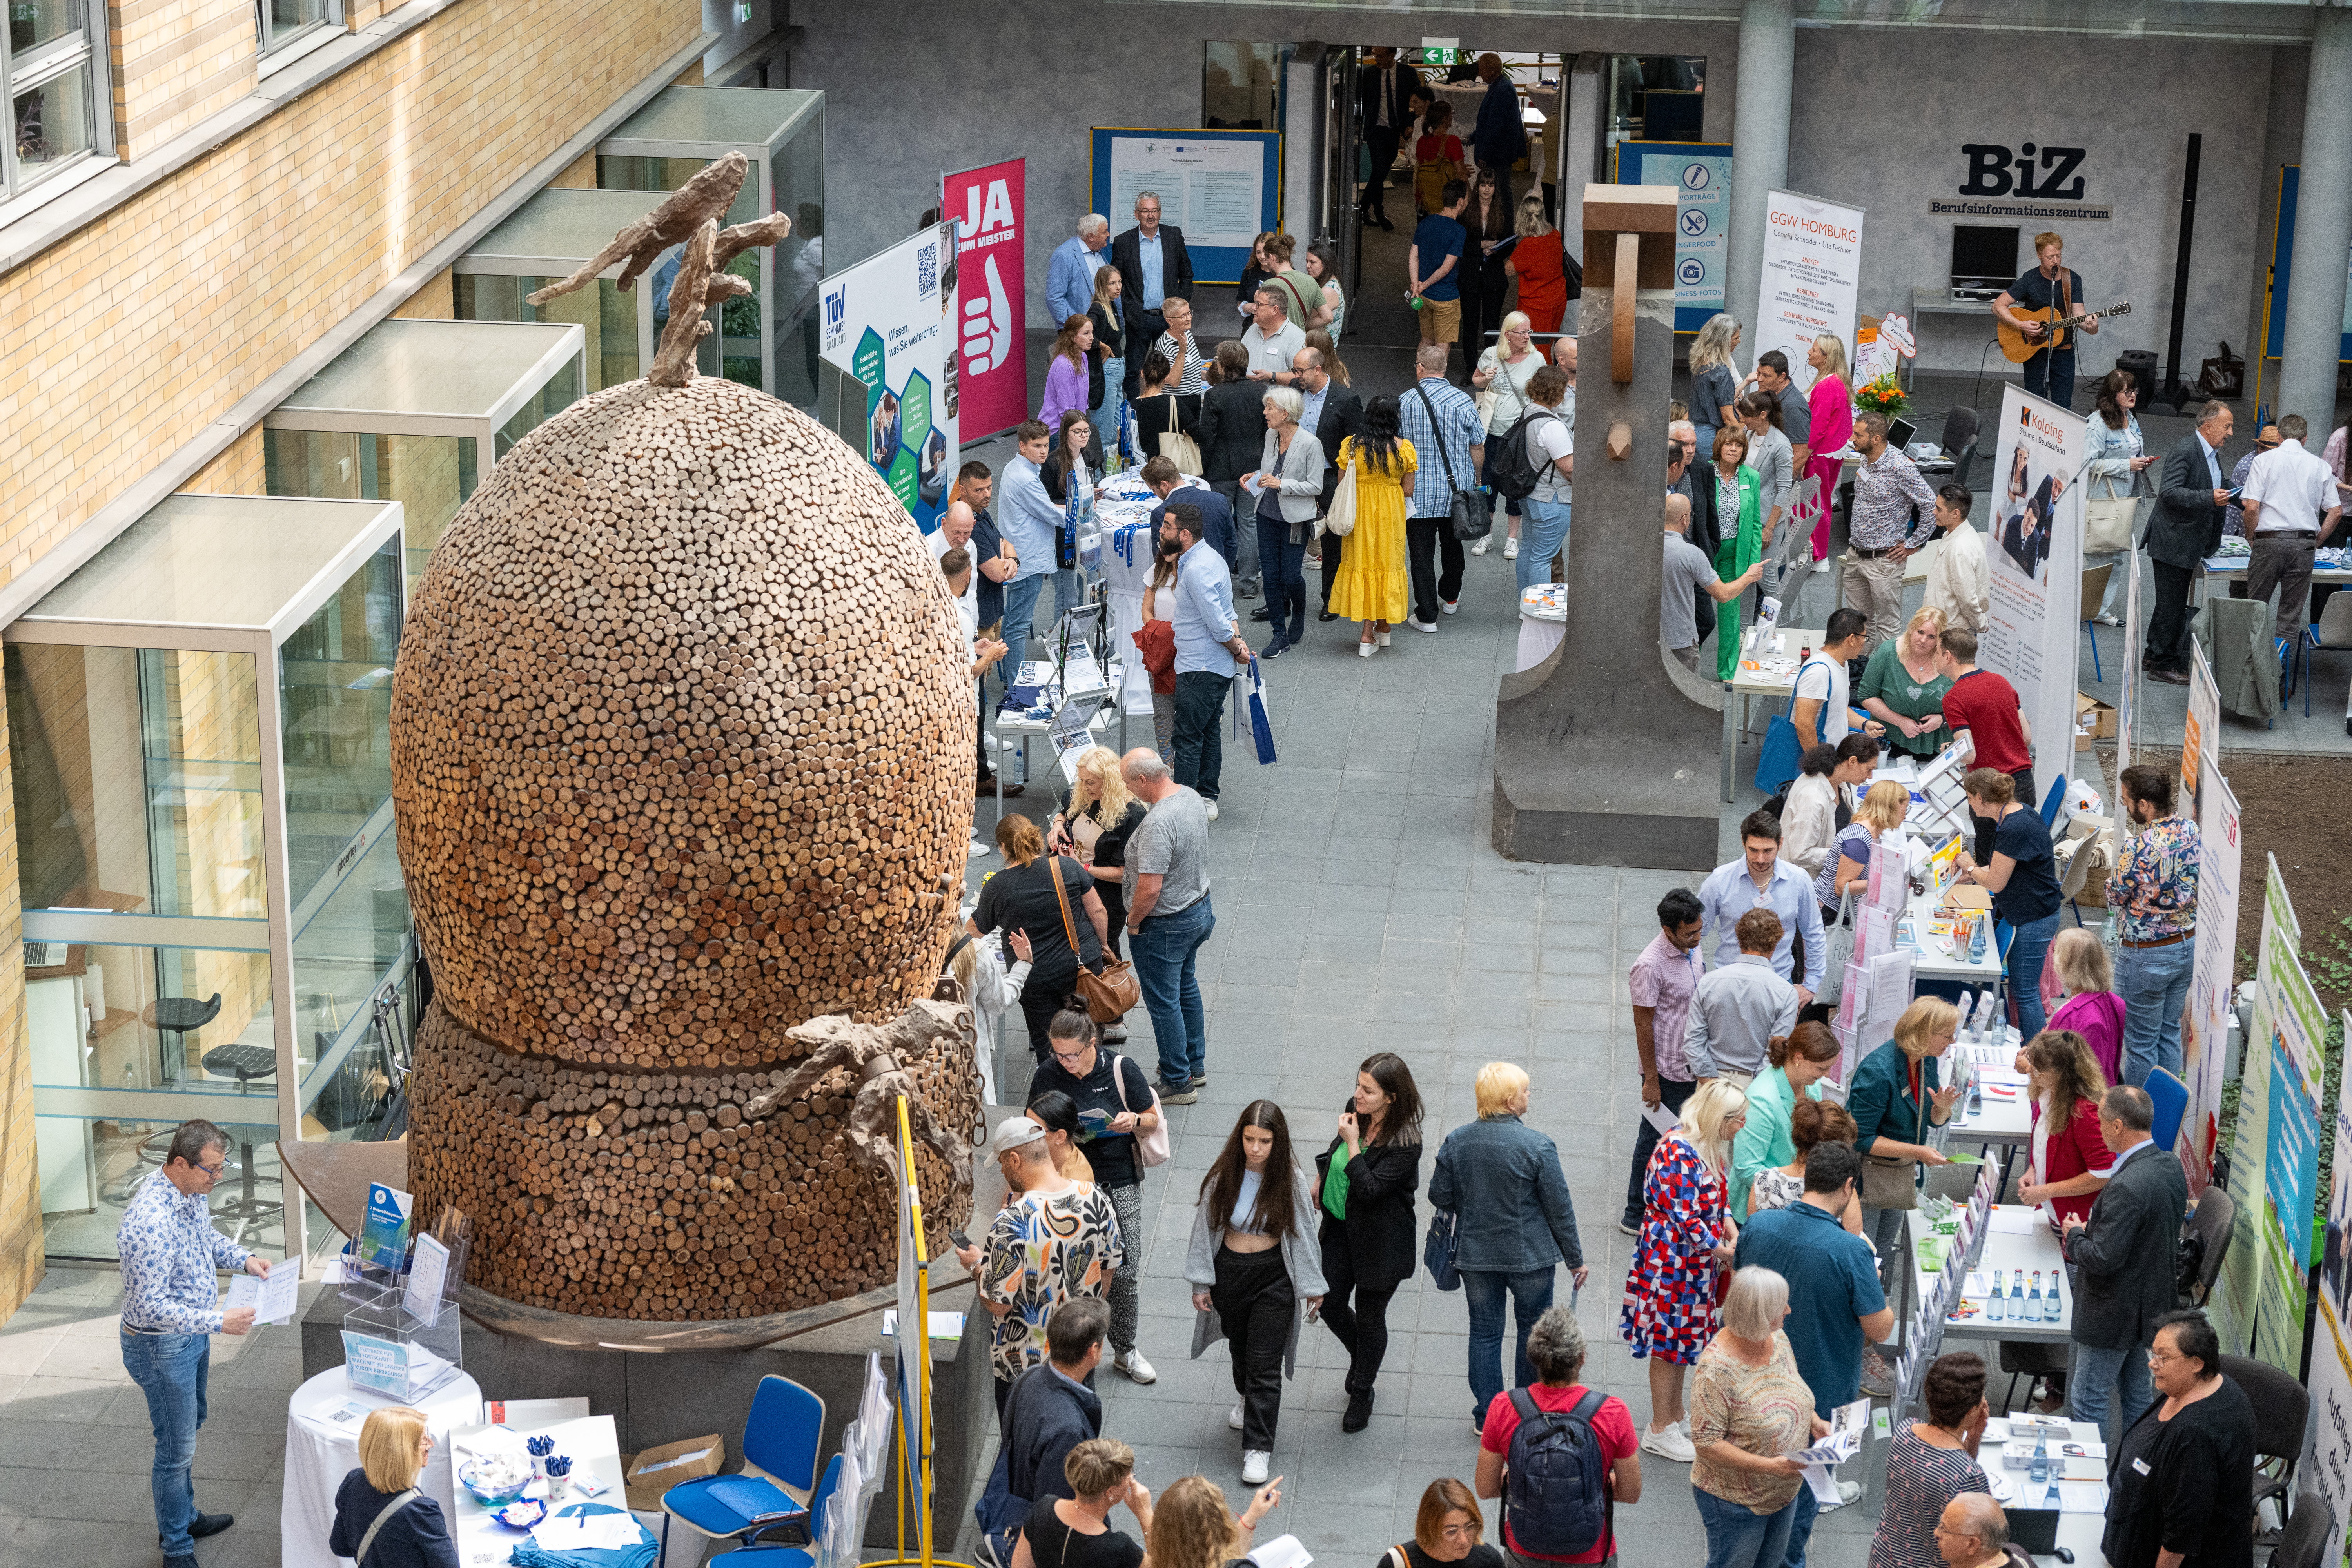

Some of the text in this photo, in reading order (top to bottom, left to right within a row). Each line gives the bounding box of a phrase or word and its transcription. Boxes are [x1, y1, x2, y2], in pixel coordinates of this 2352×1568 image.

[1959, 142, 2086, 200] BiZ
[960, 179, 1015, 240] JA
[1931, 201, 2109, 220] Berufsinformationszentrum
[1771, 211, 1856, 242] GGW HOMBURG
[958, 229, 1015, 253] ZUM MEISTER
[1773, 229, 1792, 240] Cornelia
[1794, 234, 1817, 245] Schneider
[1833, 244, 1851, 254] Fechner
[1781, 259, 1811, 270] GEFÄHRDUNGSANALYSE
[1821, 268, 1838, 277] BELASTUNGEN
[1802, 257, 1819, 265] ANALYSEN
[1769, 261, 1786, 270] ERGONOMISCH
[1788, 267, 1820, 279] PHYSIOTHERAPEUTISCHE
[1820, 275, 1851, 286] ARBEITSPLATZANALYSEN
[1791, 274, 1827, 286] MITARBEITERBEFRAGUNGEN
[1779, 290, 1835, 309] BETRIEBLICHES GESUNDHEITSMANAGEMENT
[1797, 288, 1819, 298] BERATUNGEN
[825, 283, 845, 326] TÜV
[1775, 296, 1800, 306] DEMOGRAFISCHER
[1820, 307, 1837, 315] ARBEITSWELT
[1784, 311, 1802, 321] SEMINARE
[1805, 316, 1827, 327] WORKSHOPS
[889, 325, 909, 341] Wissen,
[1795, 334, 1812, 343] COACHING
[1813, 325, 1833, 334] LEBENSPHASEN
[826, 332, 846, 352] SAARLAND
[889, 347, 899, 357] was
[909, 322, 939, 347] weiterbringt.
[858, 359, 879, 374] Lösungshilfen
[860, 350, 877, 364] Betriebliche
[1883, 352, 1893, 371] Coaching
[909, 394, 922, 404] Inhouse-
[909, 402, 923, 414] Lösungen
[913, 412, 922, 421] Online
[2032, 413, 2063, 444] Kolping
[2019, 427, 2065, 455] Bildung Deutschland
[894, 473, 912, 489] Zufriedenheit
[901, 484, 909, 493] unser
[1990, 577, 2000, 588] Kolping
[2001, 583, 2012, 594] Bildung
[2013, 590, 2031, 604] Deutschland:
[2004, 577, 2040, 600] Weiterbildungsangebote
[1995, 588, 2005, 597] unserer
[2005, 593, 2022, 607] langjährigen
[2022, 603, 2036, 615] Erfahrung
[1998, 598, 2011, 608] Netzwerk
[2016, 608, 2034, 622] Arbeitsmarkt
[1990, 624, 2008, 637] Umschulungen
[1991, 613, 2016, 632] Unsere Angebote:
[1988, 639, 2011, 655] Teilqualifizierungen
[1989, 632, 2009, 646] Qualifizierungen
[1986, 654, 2012, 673] Prüfungsvorbereitung
[1987, 646, 2010, 664] Berufsvorbereitung
[2022, 659, 2032, 668] Inhouse
[2023, 651, 2035, 661] Seminare
[2021, 666, 2029, 675] Events
[2278, 947, 2301, 1004] Fachschule
[2308, 1003, 2324, 1050] Technik
[2285, 1002, 2297, 1031] Saarland
[373, 1207, 403, 1220] Weiterbildungsmesse
[360, 1347, 383, 1355] FEEDBACK
[374, 1368, 403, 1377] BEFRAGUNG!
[2328, 1387, 2351, 1464] Aufstieg
[2329, 1447, 2345, 1500] durch
[2311, 1441, 2339, 1545] Fortbildung
